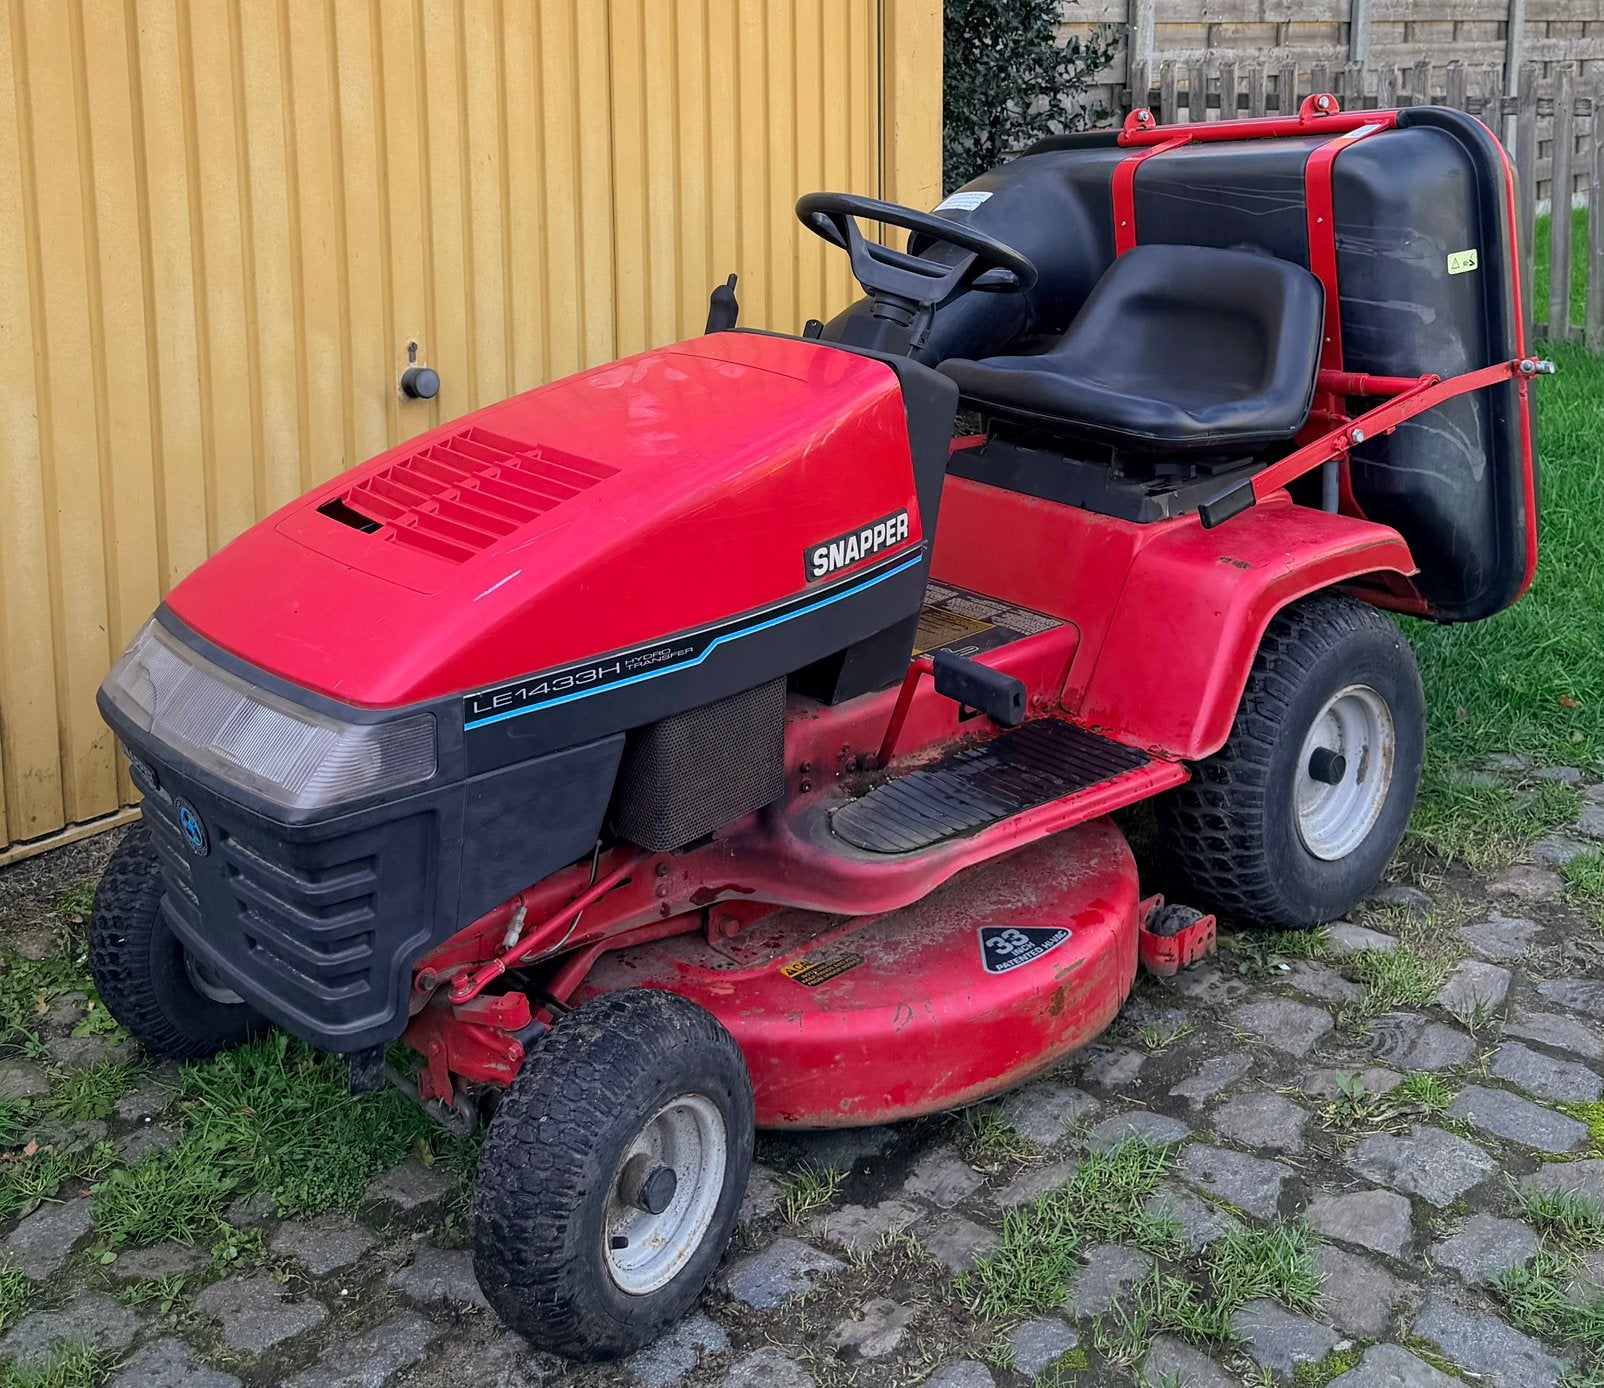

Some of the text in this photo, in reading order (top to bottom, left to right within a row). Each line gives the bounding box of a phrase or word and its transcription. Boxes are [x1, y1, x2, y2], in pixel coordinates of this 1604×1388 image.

[813, 512, 909, 577] SNAPPER
[625, 648, 671, 665] HYDRO
[626, 647, 693, 670] TRANSFER
[473, 662, 620, 714] LE1433H
[985, 928, 1029, 955] 33
[1010, 941, 1036, 956] INCH
[995, 946, 1044, 971] PATENTED
